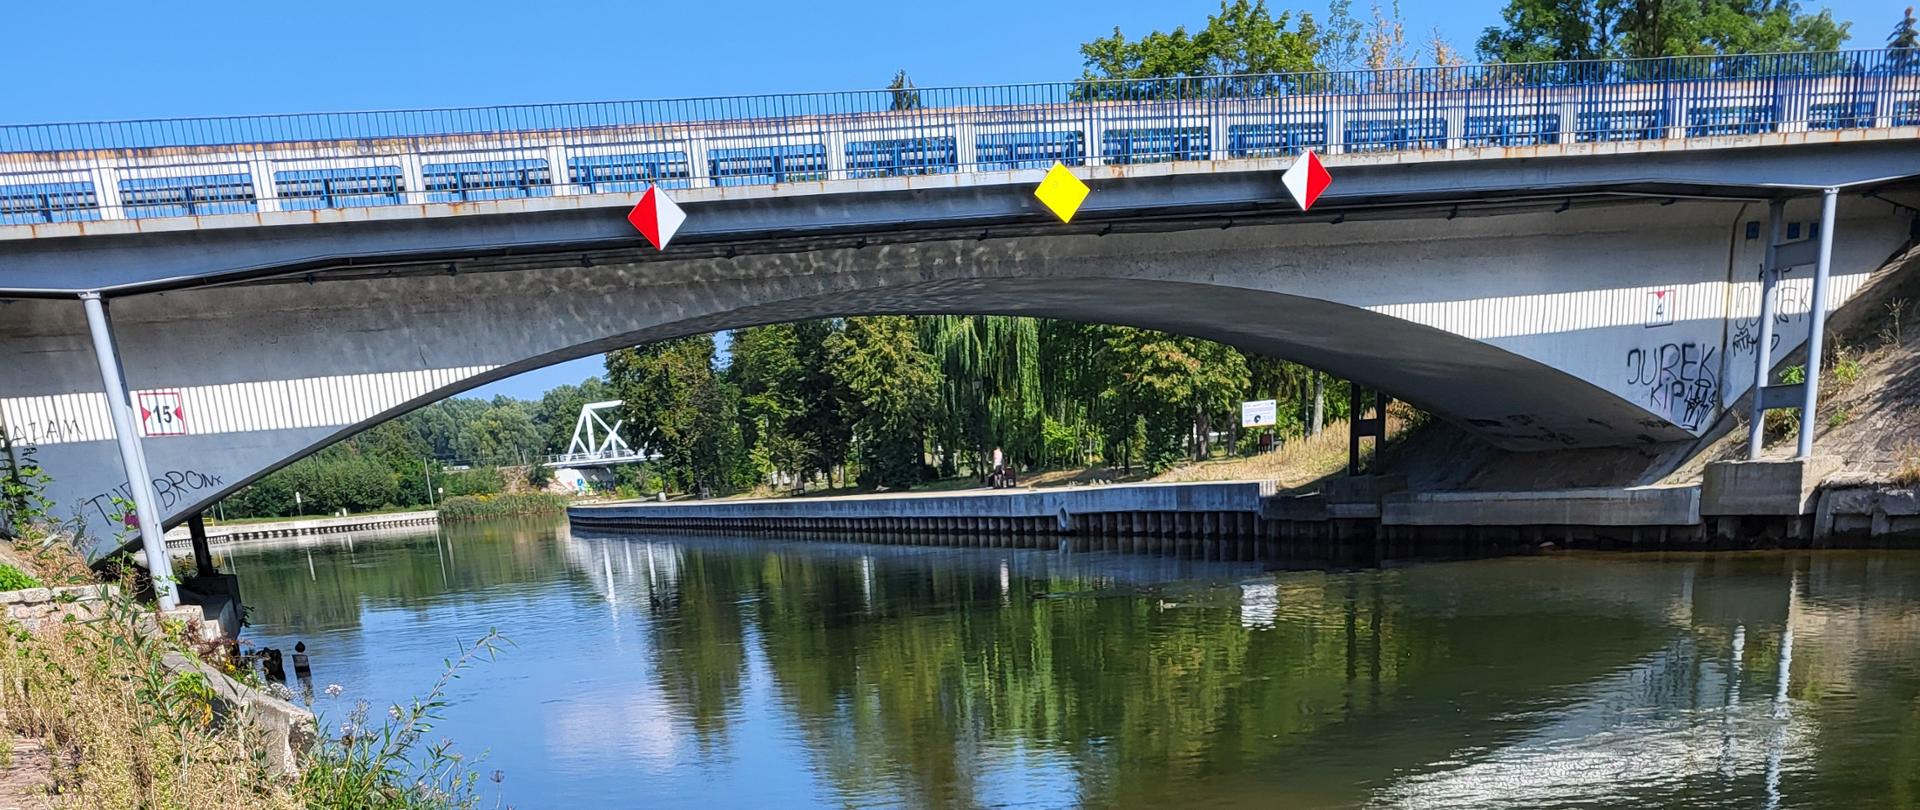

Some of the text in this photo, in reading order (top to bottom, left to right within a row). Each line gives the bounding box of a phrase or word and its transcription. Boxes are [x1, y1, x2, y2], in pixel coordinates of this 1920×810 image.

[1655, 304, 1664, 318] 4
[1627, 343, 1717, 387] JUREK
[153, 405, 172, 423] 15
